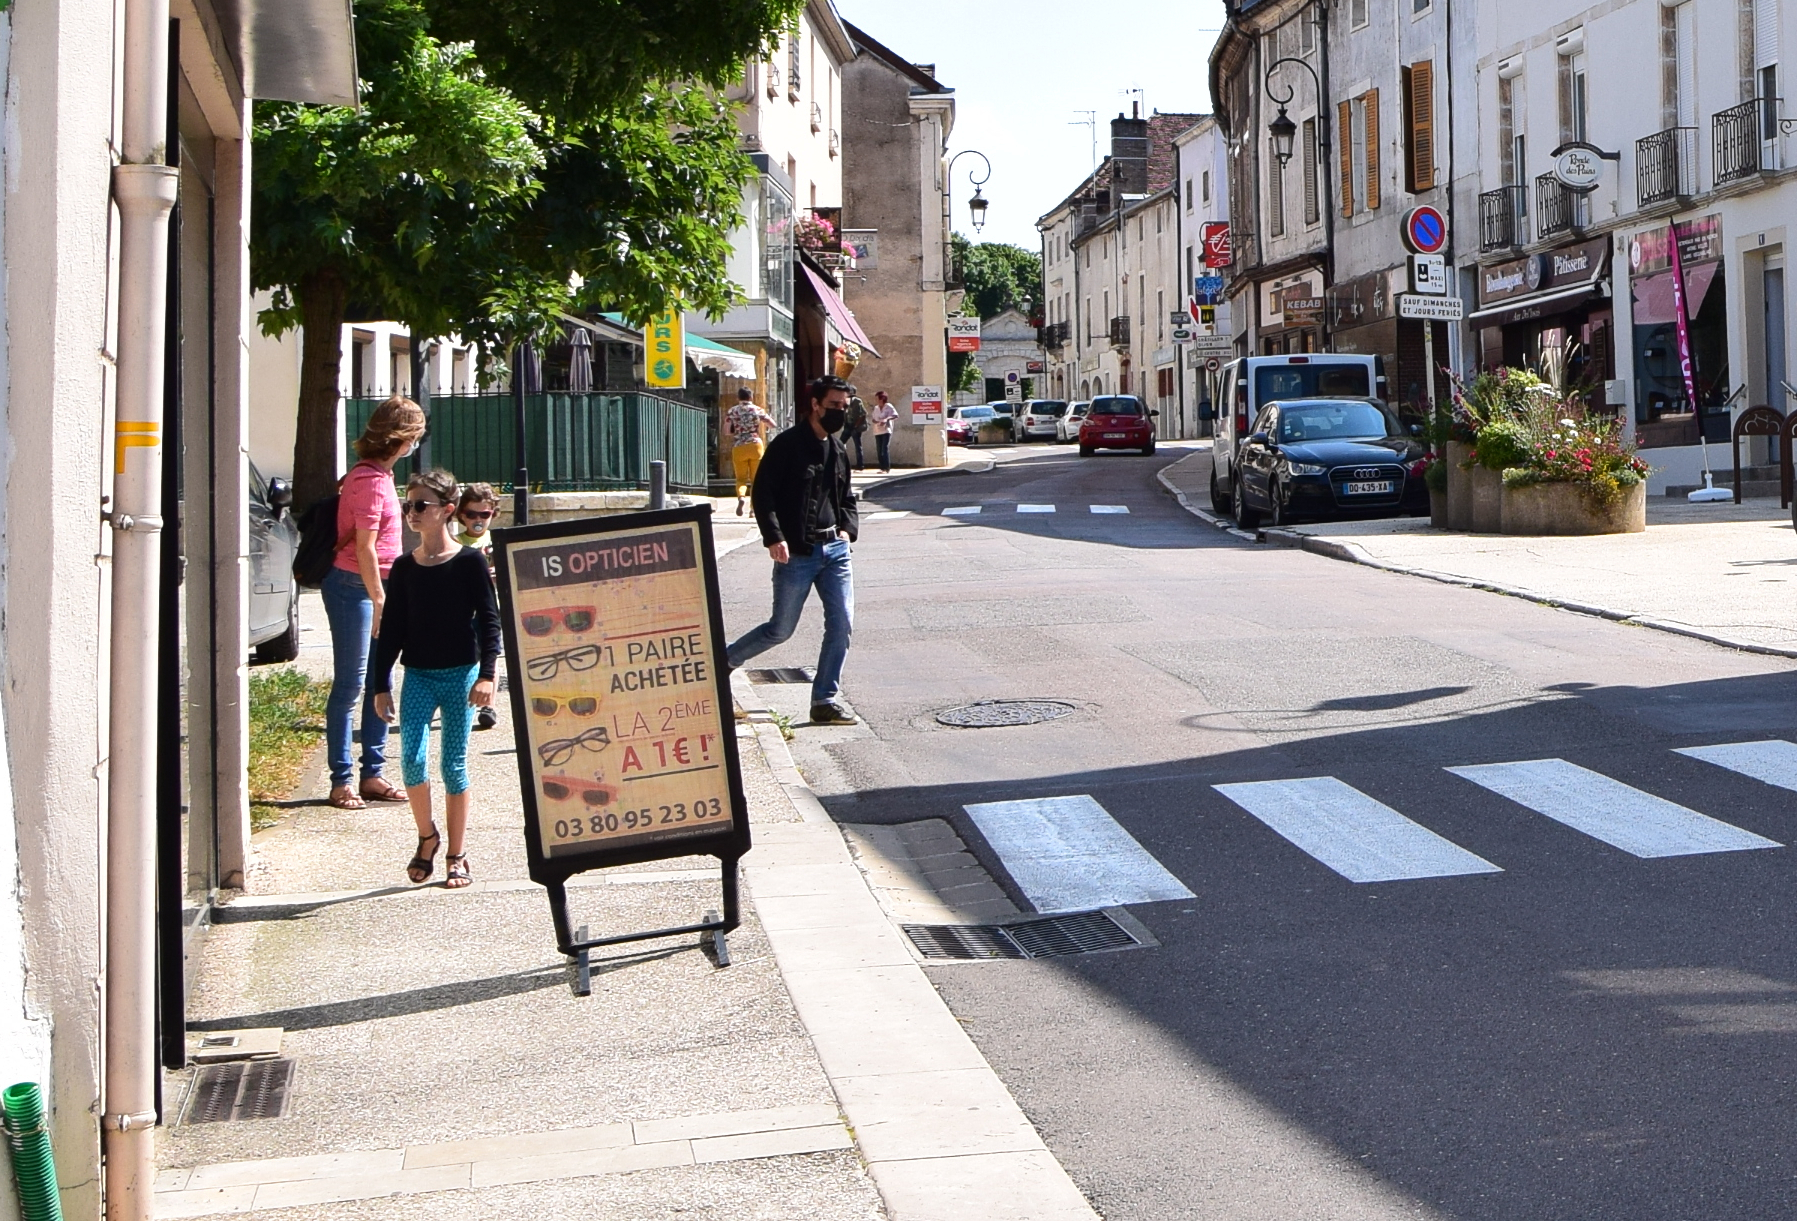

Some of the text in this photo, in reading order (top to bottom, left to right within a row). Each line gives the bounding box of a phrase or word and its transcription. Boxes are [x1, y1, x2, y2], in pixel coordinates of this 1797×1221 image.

[1287, 299, 1321, 310] KEBAB
[1403, 298, 1461, 308] SAUF DIMANCHES
[1413, 308, 1436, 316] JOURS
[541, 541, 669, 578] IS OPTICIEN
[604, 633, 704, 667] 1 PAIRE
[610, 657, 708, 694] ACHETÉE
[613, 699, 712, 739] LA 2ÈME
[621, 745, 644, 773] A
[652, 736, 691, 768] 1€
[554, 797, 723, 839] 03 80 95 23 03
